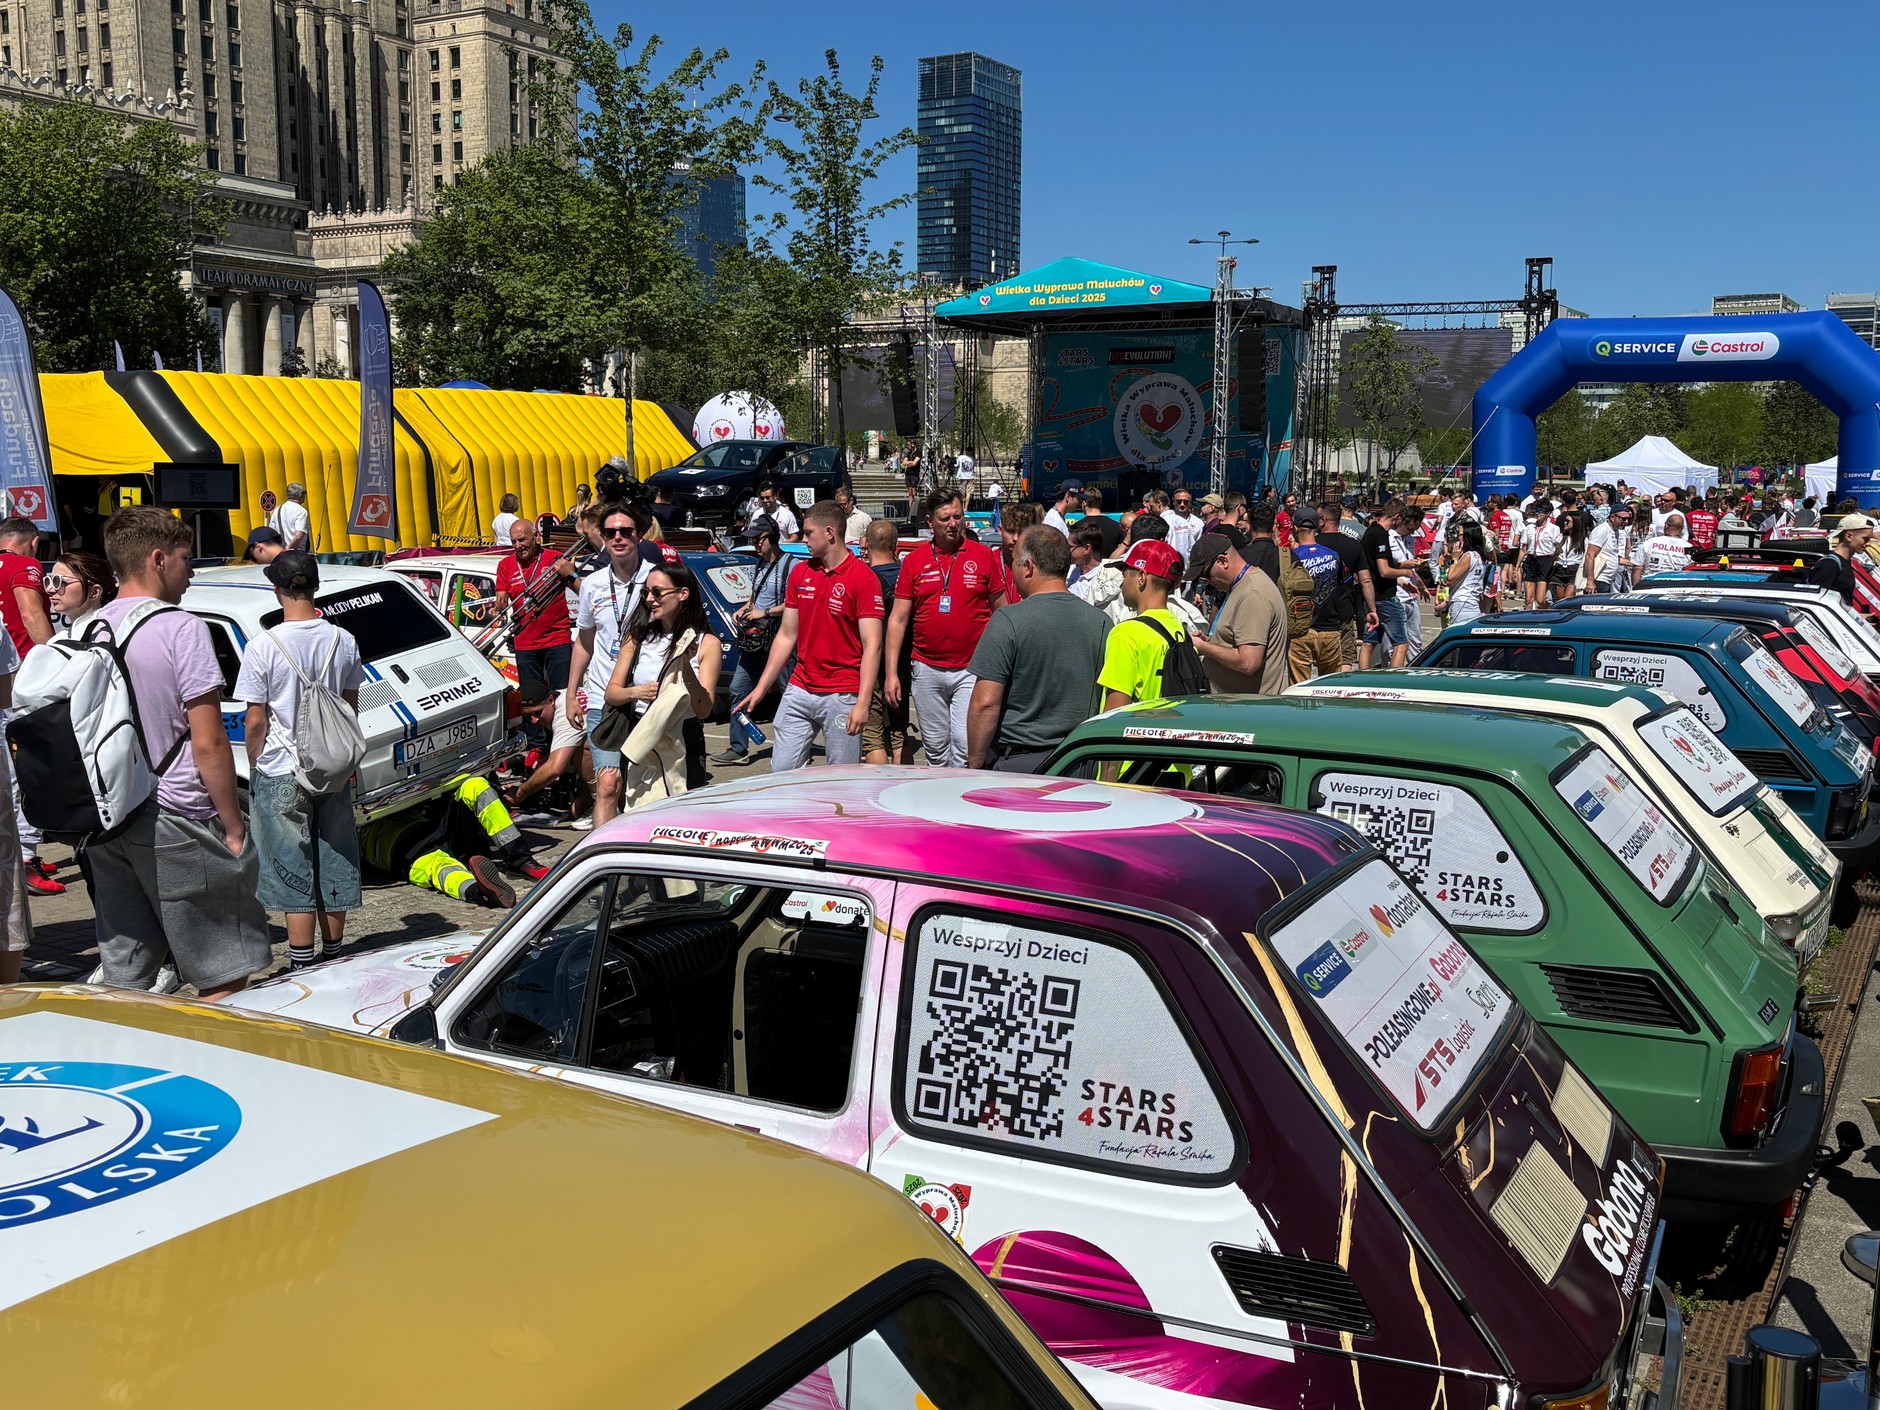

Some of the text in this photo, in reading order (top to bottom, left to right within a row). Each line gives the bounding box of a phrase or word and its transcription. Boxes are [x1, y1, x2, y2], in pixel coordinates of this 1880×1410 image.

[200, 268, 313, 292] TEATR DRAMATYCZNY
[995, 277, 1145, 297] Wielka Wyprawa Maluchów
[1029, 292, 1106, 307] dla Dzieci 2025
[1059, 348, 1089, 357] STARS
[1613, 343, 1676, 354] SERVICE
[1711, 340, 1765, 354] Castrol
[1120, 381, 1198, 445] Wielka Wyprawa Maluchów
[1131, 449, 1146, 462] dla
[1308, 559, 1338, 577] OTOSPORT
[323, 592, 384, 617] MŁODY PELIKAN
[1603, 654, 1668, 665] Wesprzyj Dzieci
[406, 720, 474, 760] DZA J985
[1125, 728, 1167, 738] NICEONE
[1330, 781, 1441, 802] Wesprzyj Dzieci
[652, 827, 710, 841] NICEONE
[1438, 871, 1504, 892] STARS
[784, 899, 808, 907] Castrol
[1436, 888, 1516, 908] 4STARS
[835, 902, 870, 916] donate
[1384, 892, 1422, 929] donateo
[933, 927, 1089, 965] Wesprzyj Dzieci
[1348, 927, 1370, 951] Castrol
[1313, 951, 1344, 982] SERVICE
[1429, 940, 1467, 982] Gabona
[1364, 974, 1443, 1068] POLEASINGOWE.pl
[1418, 1018, 1476, 1088] STS Logistic
[1081, 1079, 1176, 1115] STARS
[1077, 1106, 1194, 1143] 4STARS
[1098, 1140, 1142, 1160] Fundacja
[0, 1124, 220, 1220] OLSKA
[904, 1177, 922, 1195] 2025
[914, 1187, 949, 1199] Wyprawa
[952, 1185, 968, 1205] 2025
[1582, 1159, 1646, 1276] Gabona
